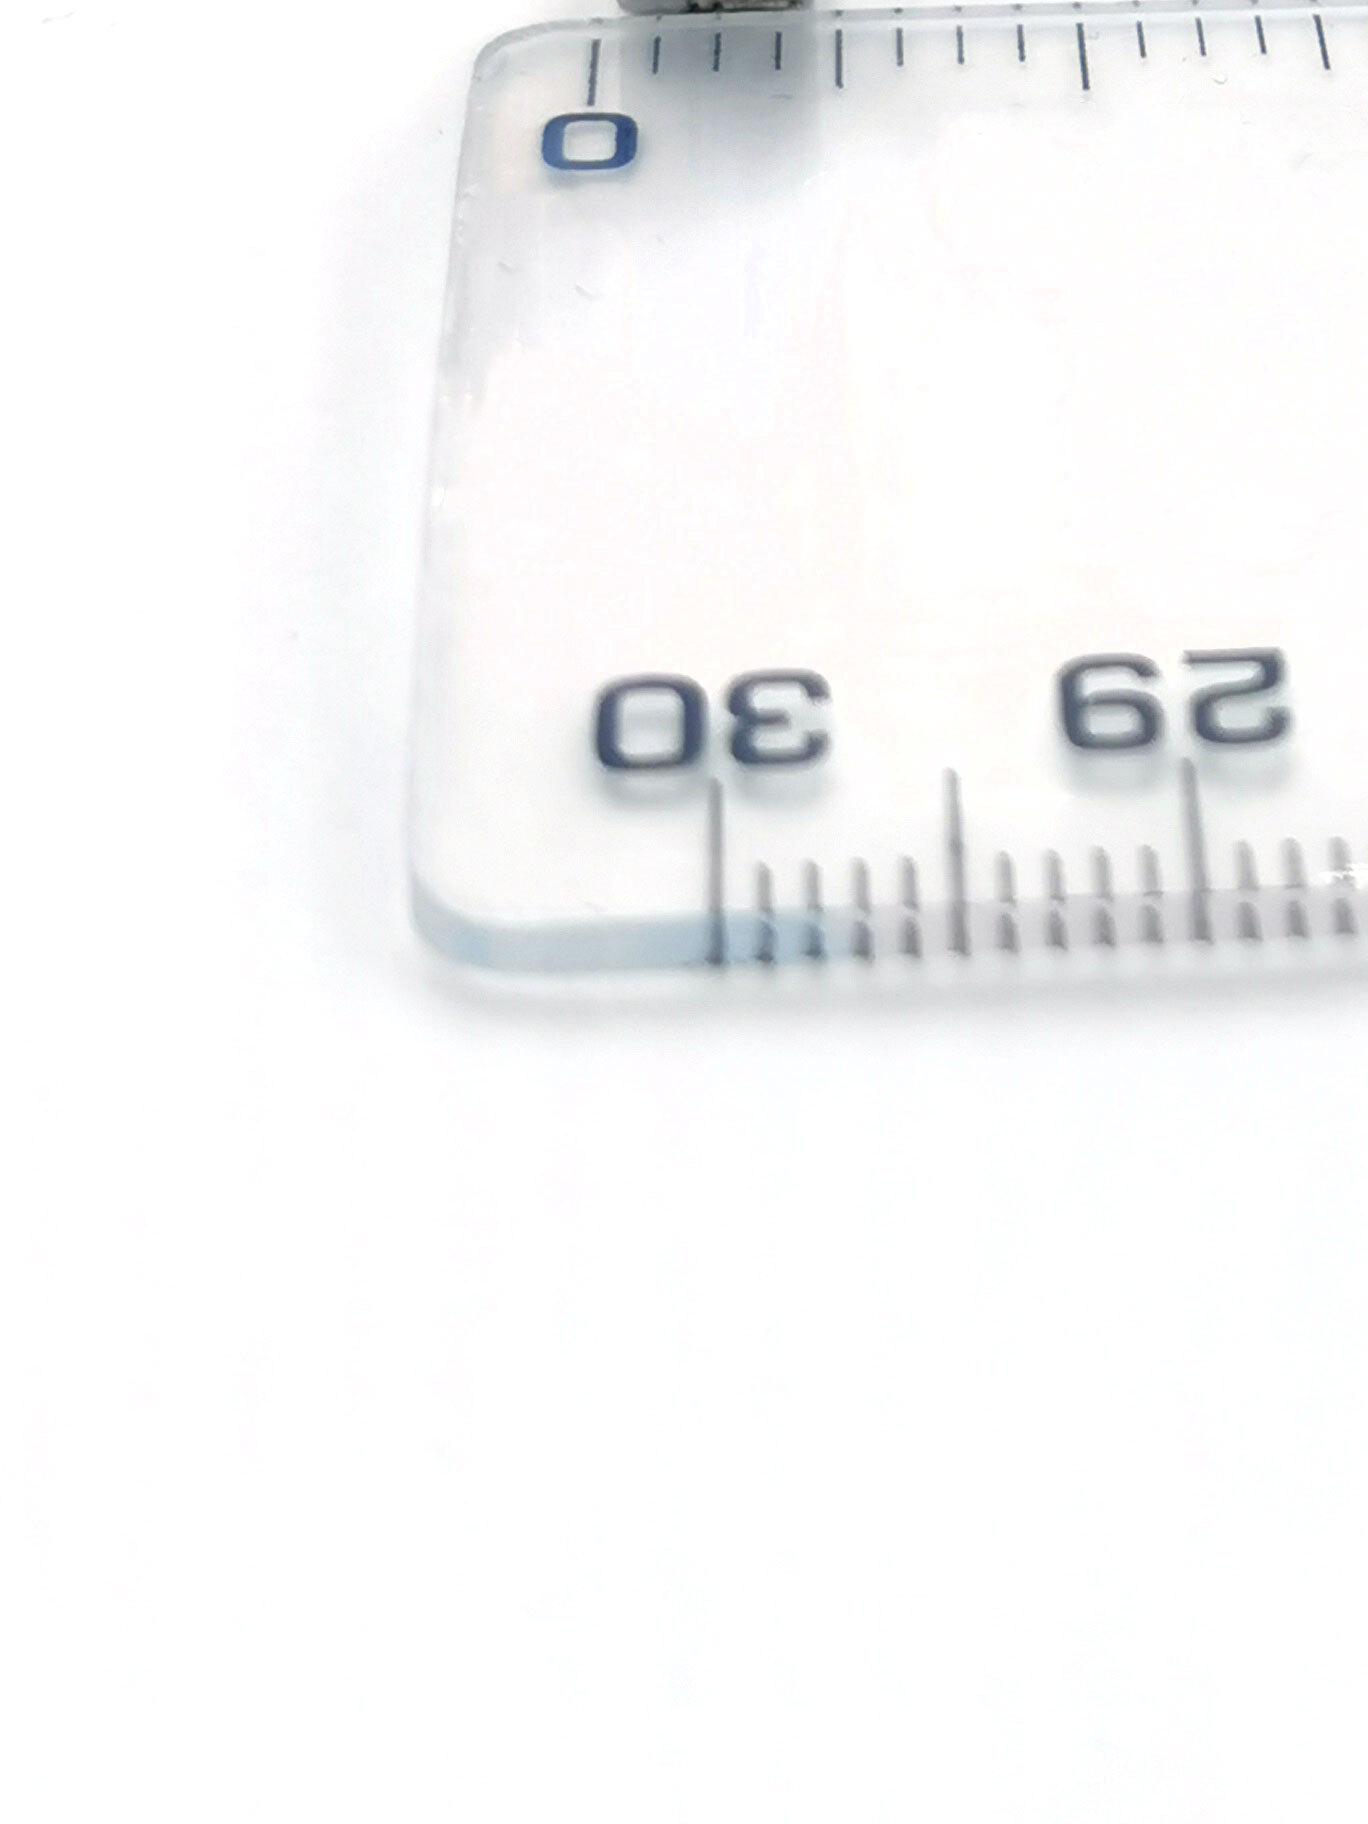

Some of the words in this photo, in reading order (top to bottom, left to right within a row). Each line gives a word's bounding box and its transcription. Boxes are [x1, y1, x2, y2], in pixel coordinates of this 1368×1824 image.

[541, 113, 639, 171] 0
[592, 673, 828, 774] 30
[1058, 652, 1289, 753] 29
